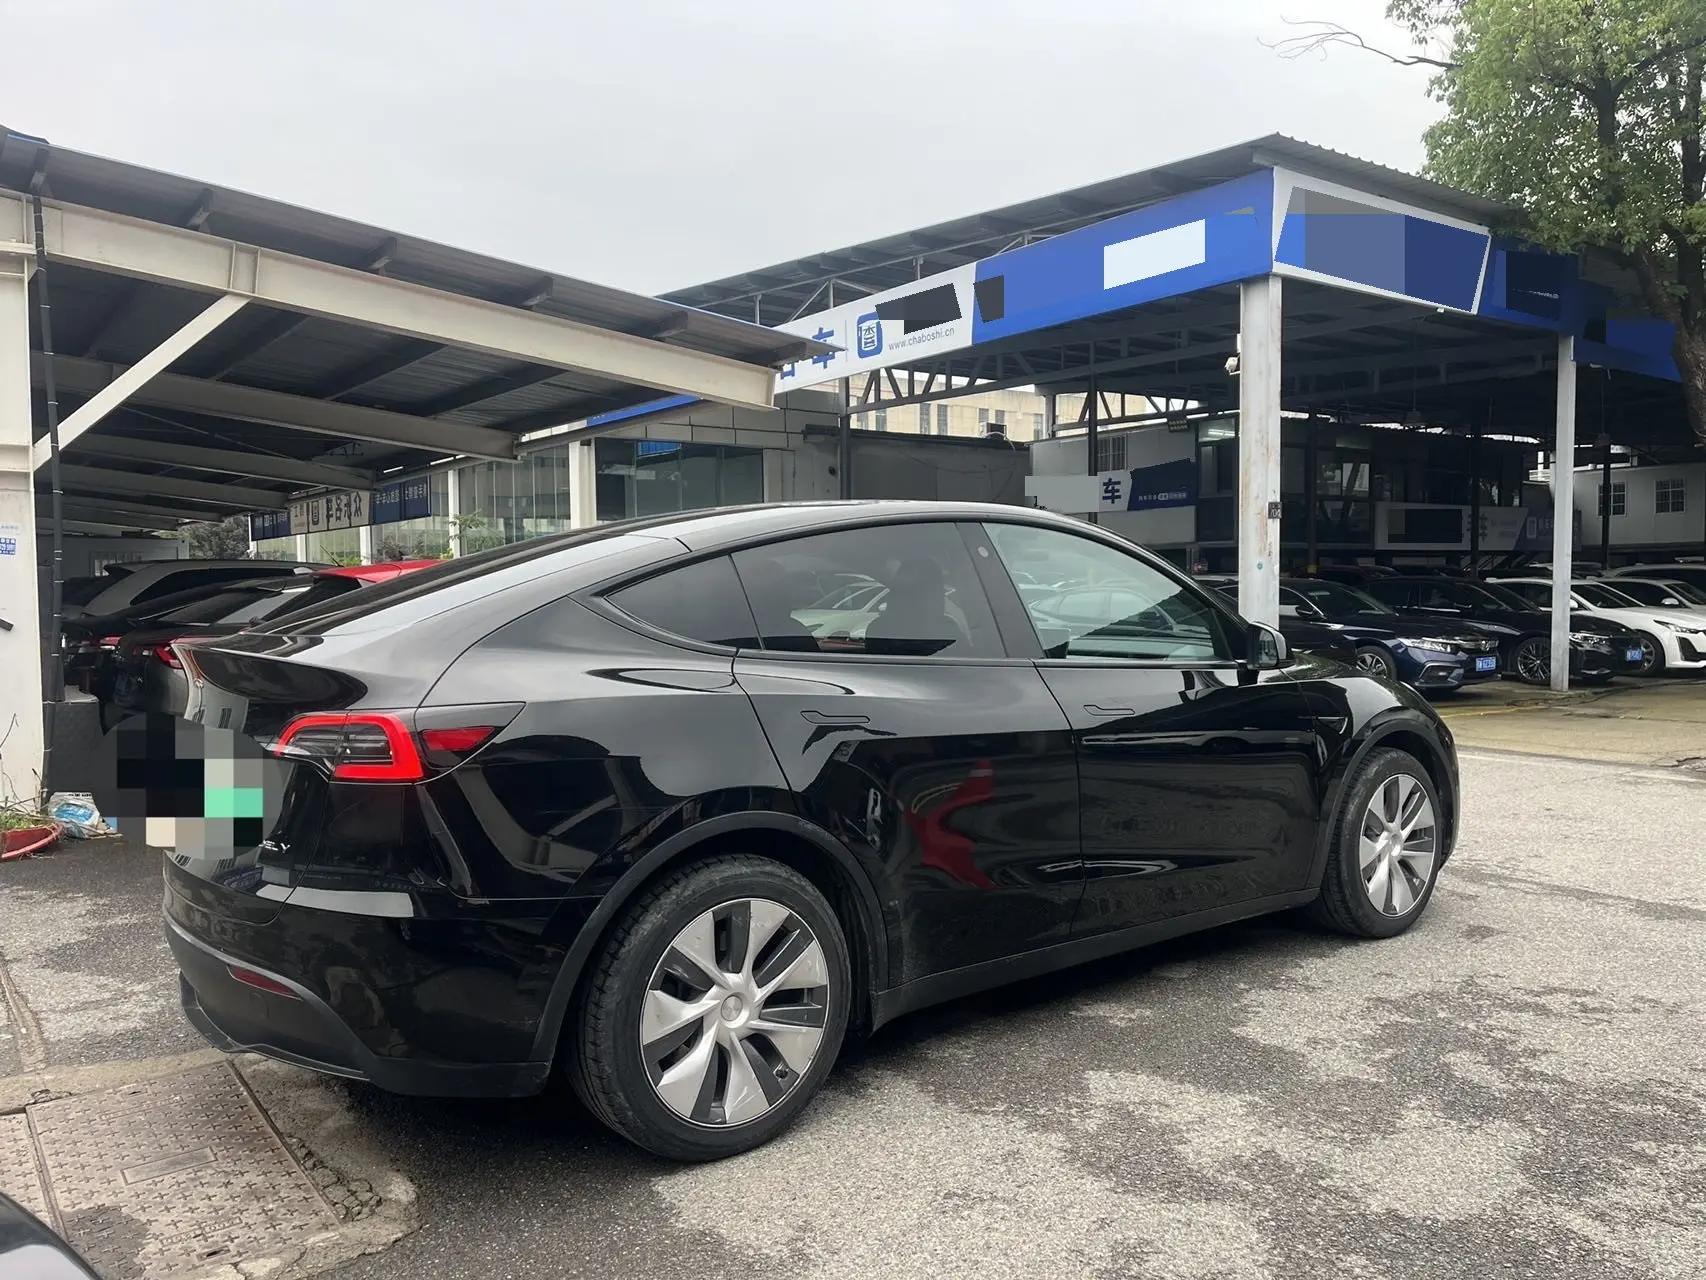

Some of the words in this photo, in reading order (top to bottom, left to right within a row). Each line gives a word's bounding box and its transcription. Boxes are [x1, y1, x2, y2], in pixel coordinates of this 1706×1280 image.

[888, 327, 955, 351] www.chaboshi.cn
[1102, 477, 1122, 504] 车
[280, 843, 291, 854] Y
